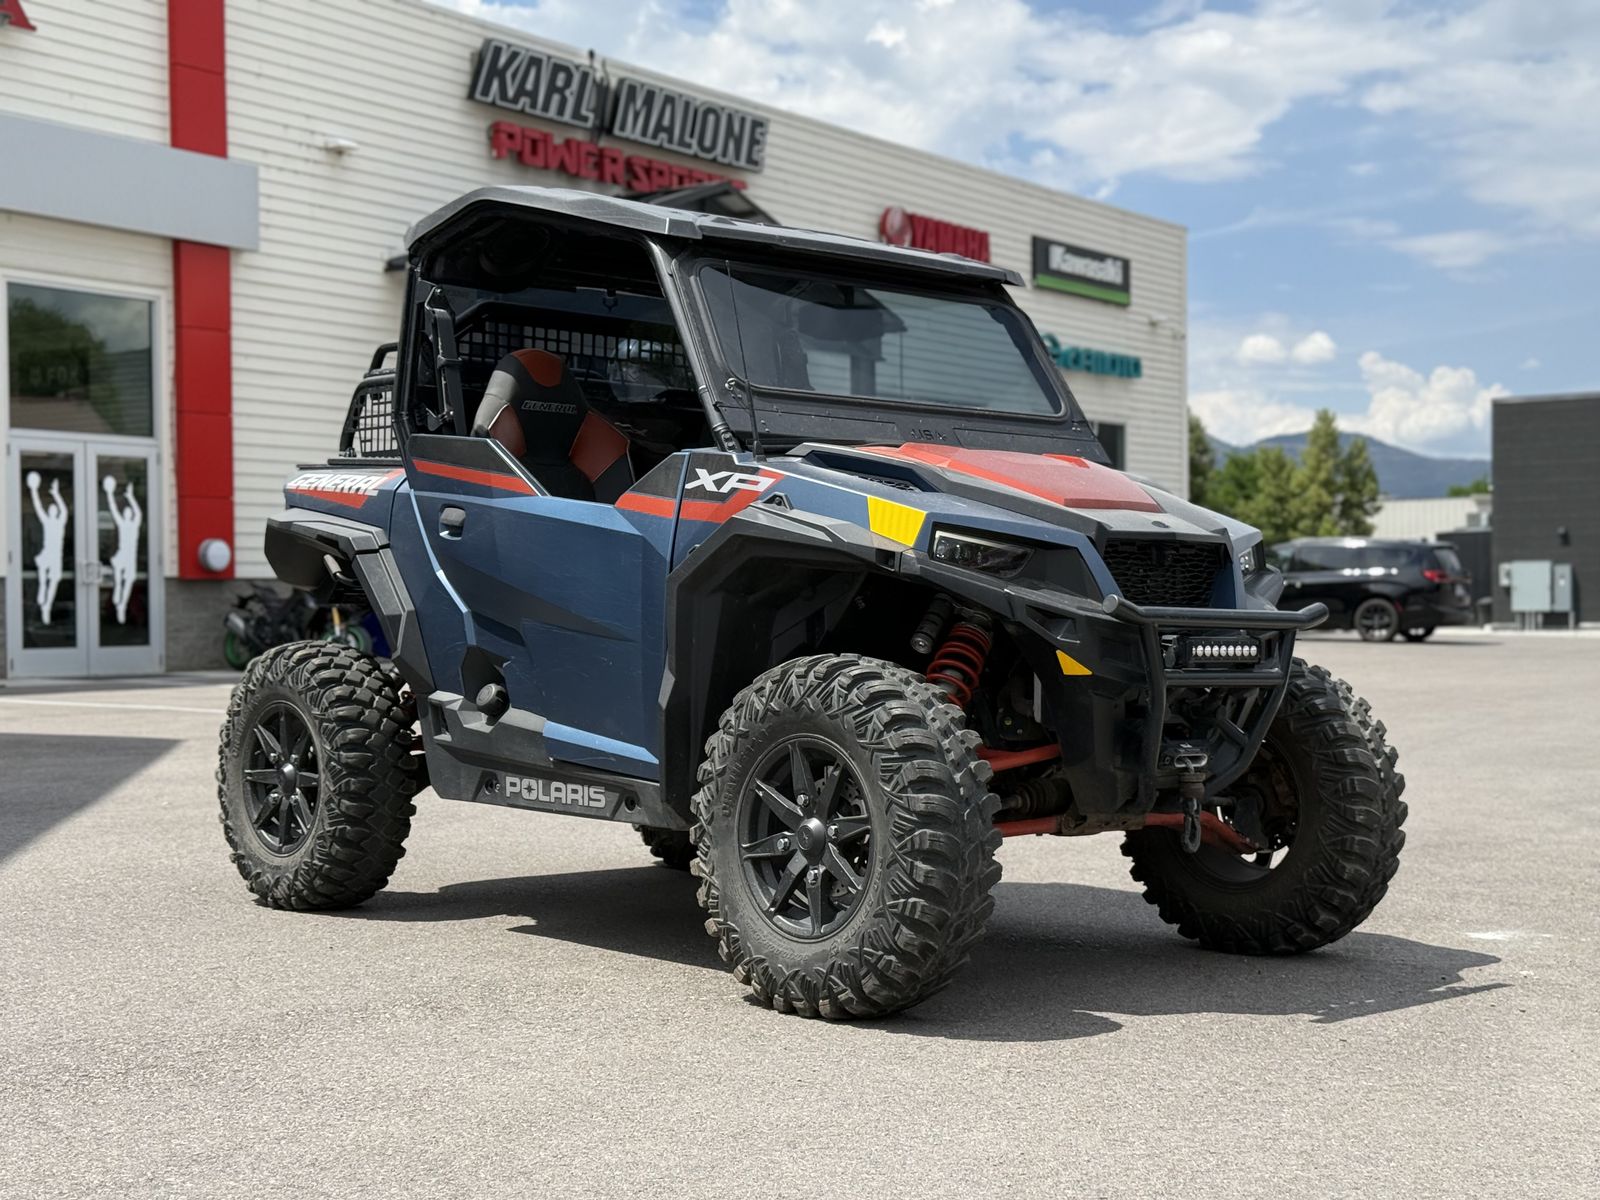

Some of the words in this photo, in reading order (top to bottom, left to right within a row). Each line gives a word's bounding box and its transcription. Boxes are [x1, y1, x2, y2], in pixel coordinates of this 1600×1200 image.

[469, 39, 595, 129] KARL
[612, 78, 769, 173] MALONE
[491, 120, 748, 193] POWERSPO
[909, 212, 990, 264] YAMAHA
[286, 473, 379, 497] GENERAL
[684, 467, 777, 494] XP
[505, 776, 606, 808] POLARIS
